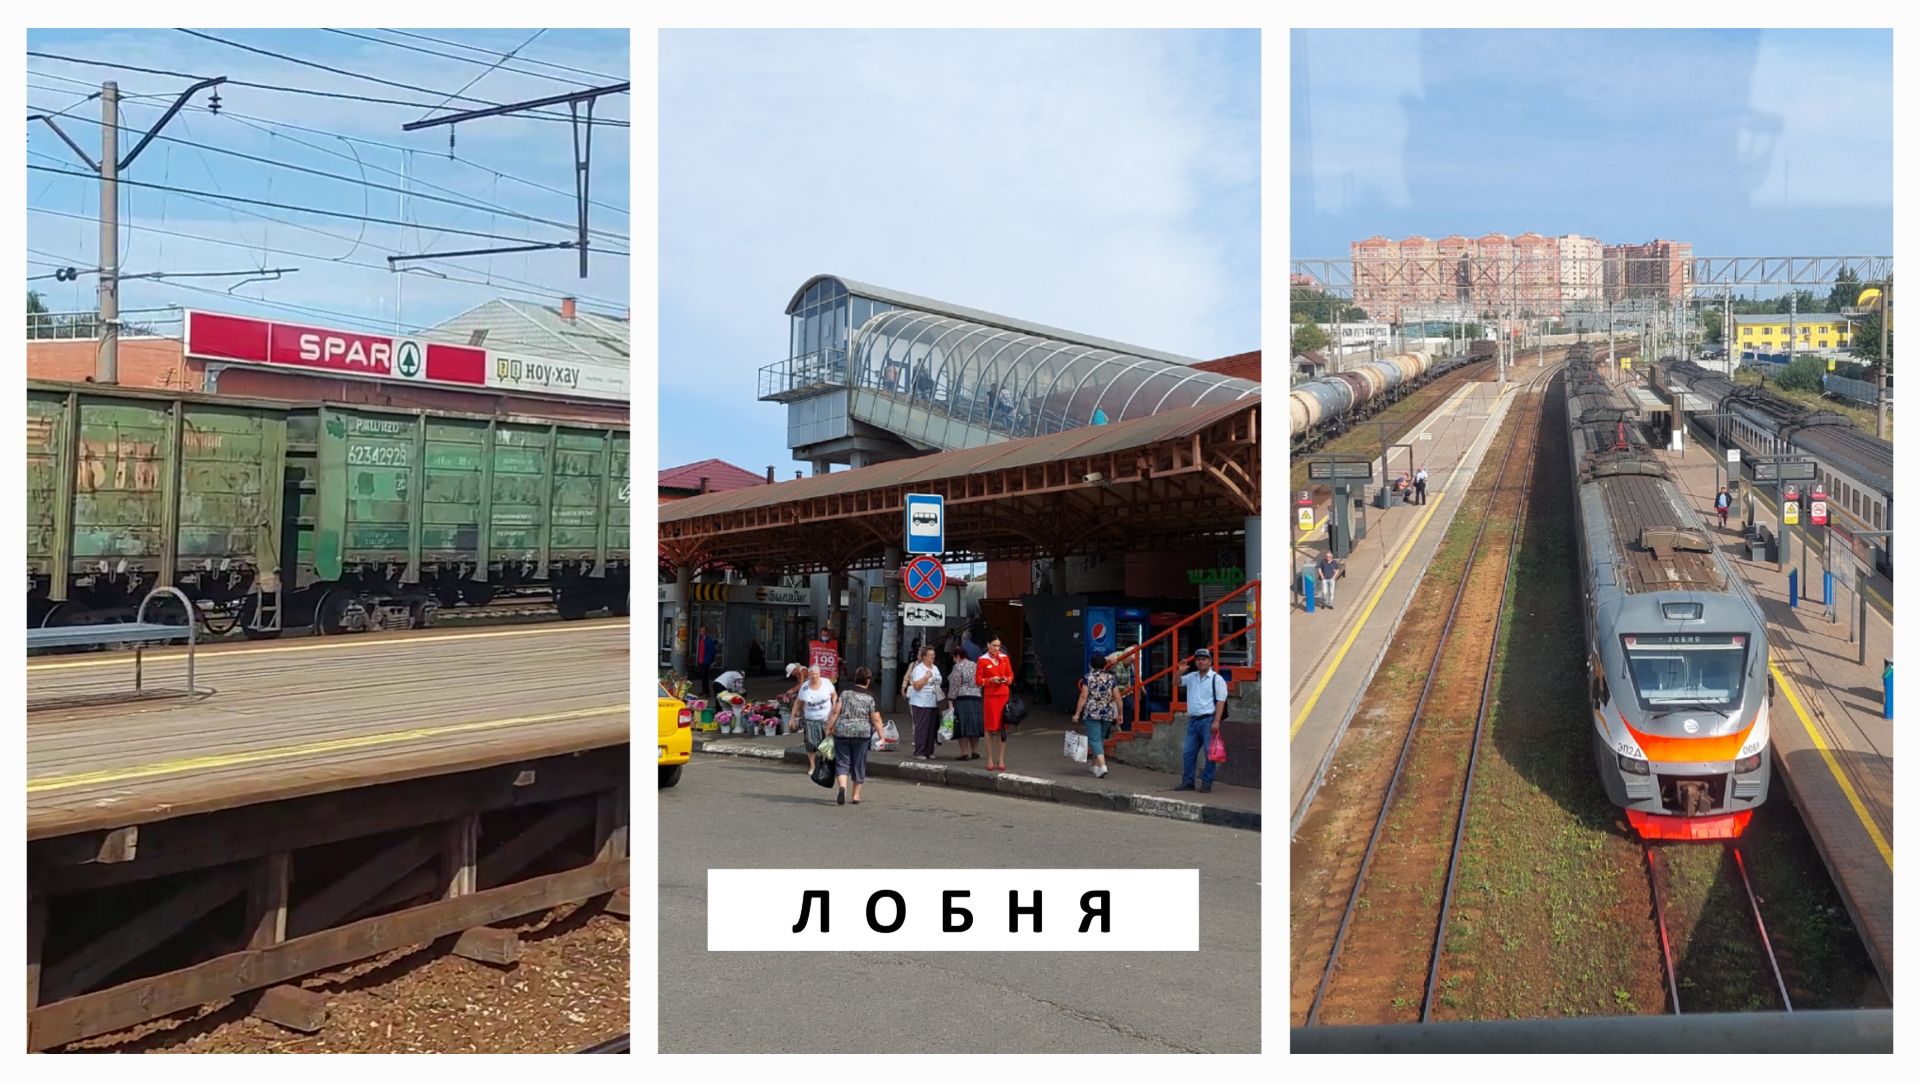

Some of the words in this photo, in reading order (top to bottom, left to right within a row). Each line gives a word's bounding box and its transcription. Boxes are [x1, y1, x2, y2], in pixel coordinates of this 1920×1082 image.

[300, 334, 390, 368] SPAR
[1301, 490, 1309, 500] 3
[1788, 485, 1795, 495] 2
[1815, 484, 1823, 495] 4
[813, 655, 835, 666] 199
[1617, 742, 1642, 758] ЭП2Д
